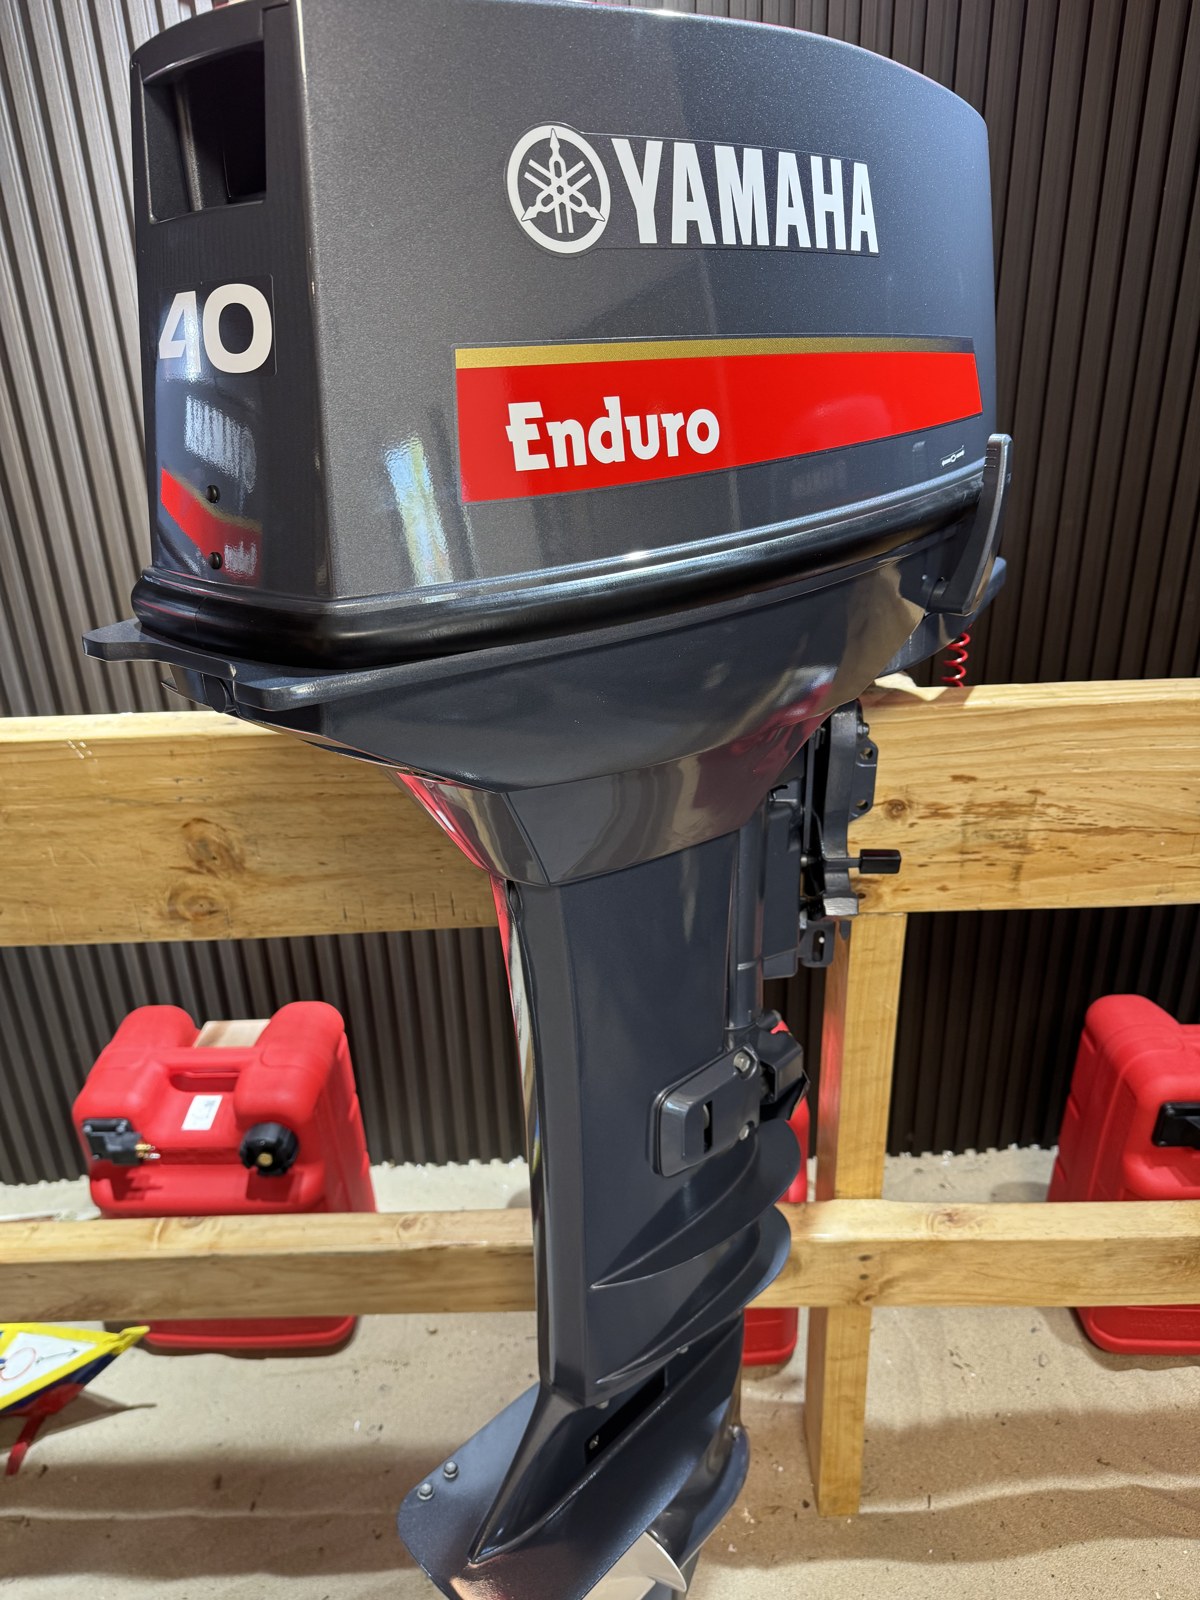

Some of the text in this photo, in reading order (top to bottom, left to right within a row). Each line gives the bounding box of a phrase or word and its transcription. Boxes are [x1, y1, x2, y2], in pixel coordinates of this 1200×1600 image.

[611, 138, 879, 254] YAMAHA
[158, 283, 273, 374] 40
[506, 396, 720, 472] Enduro
